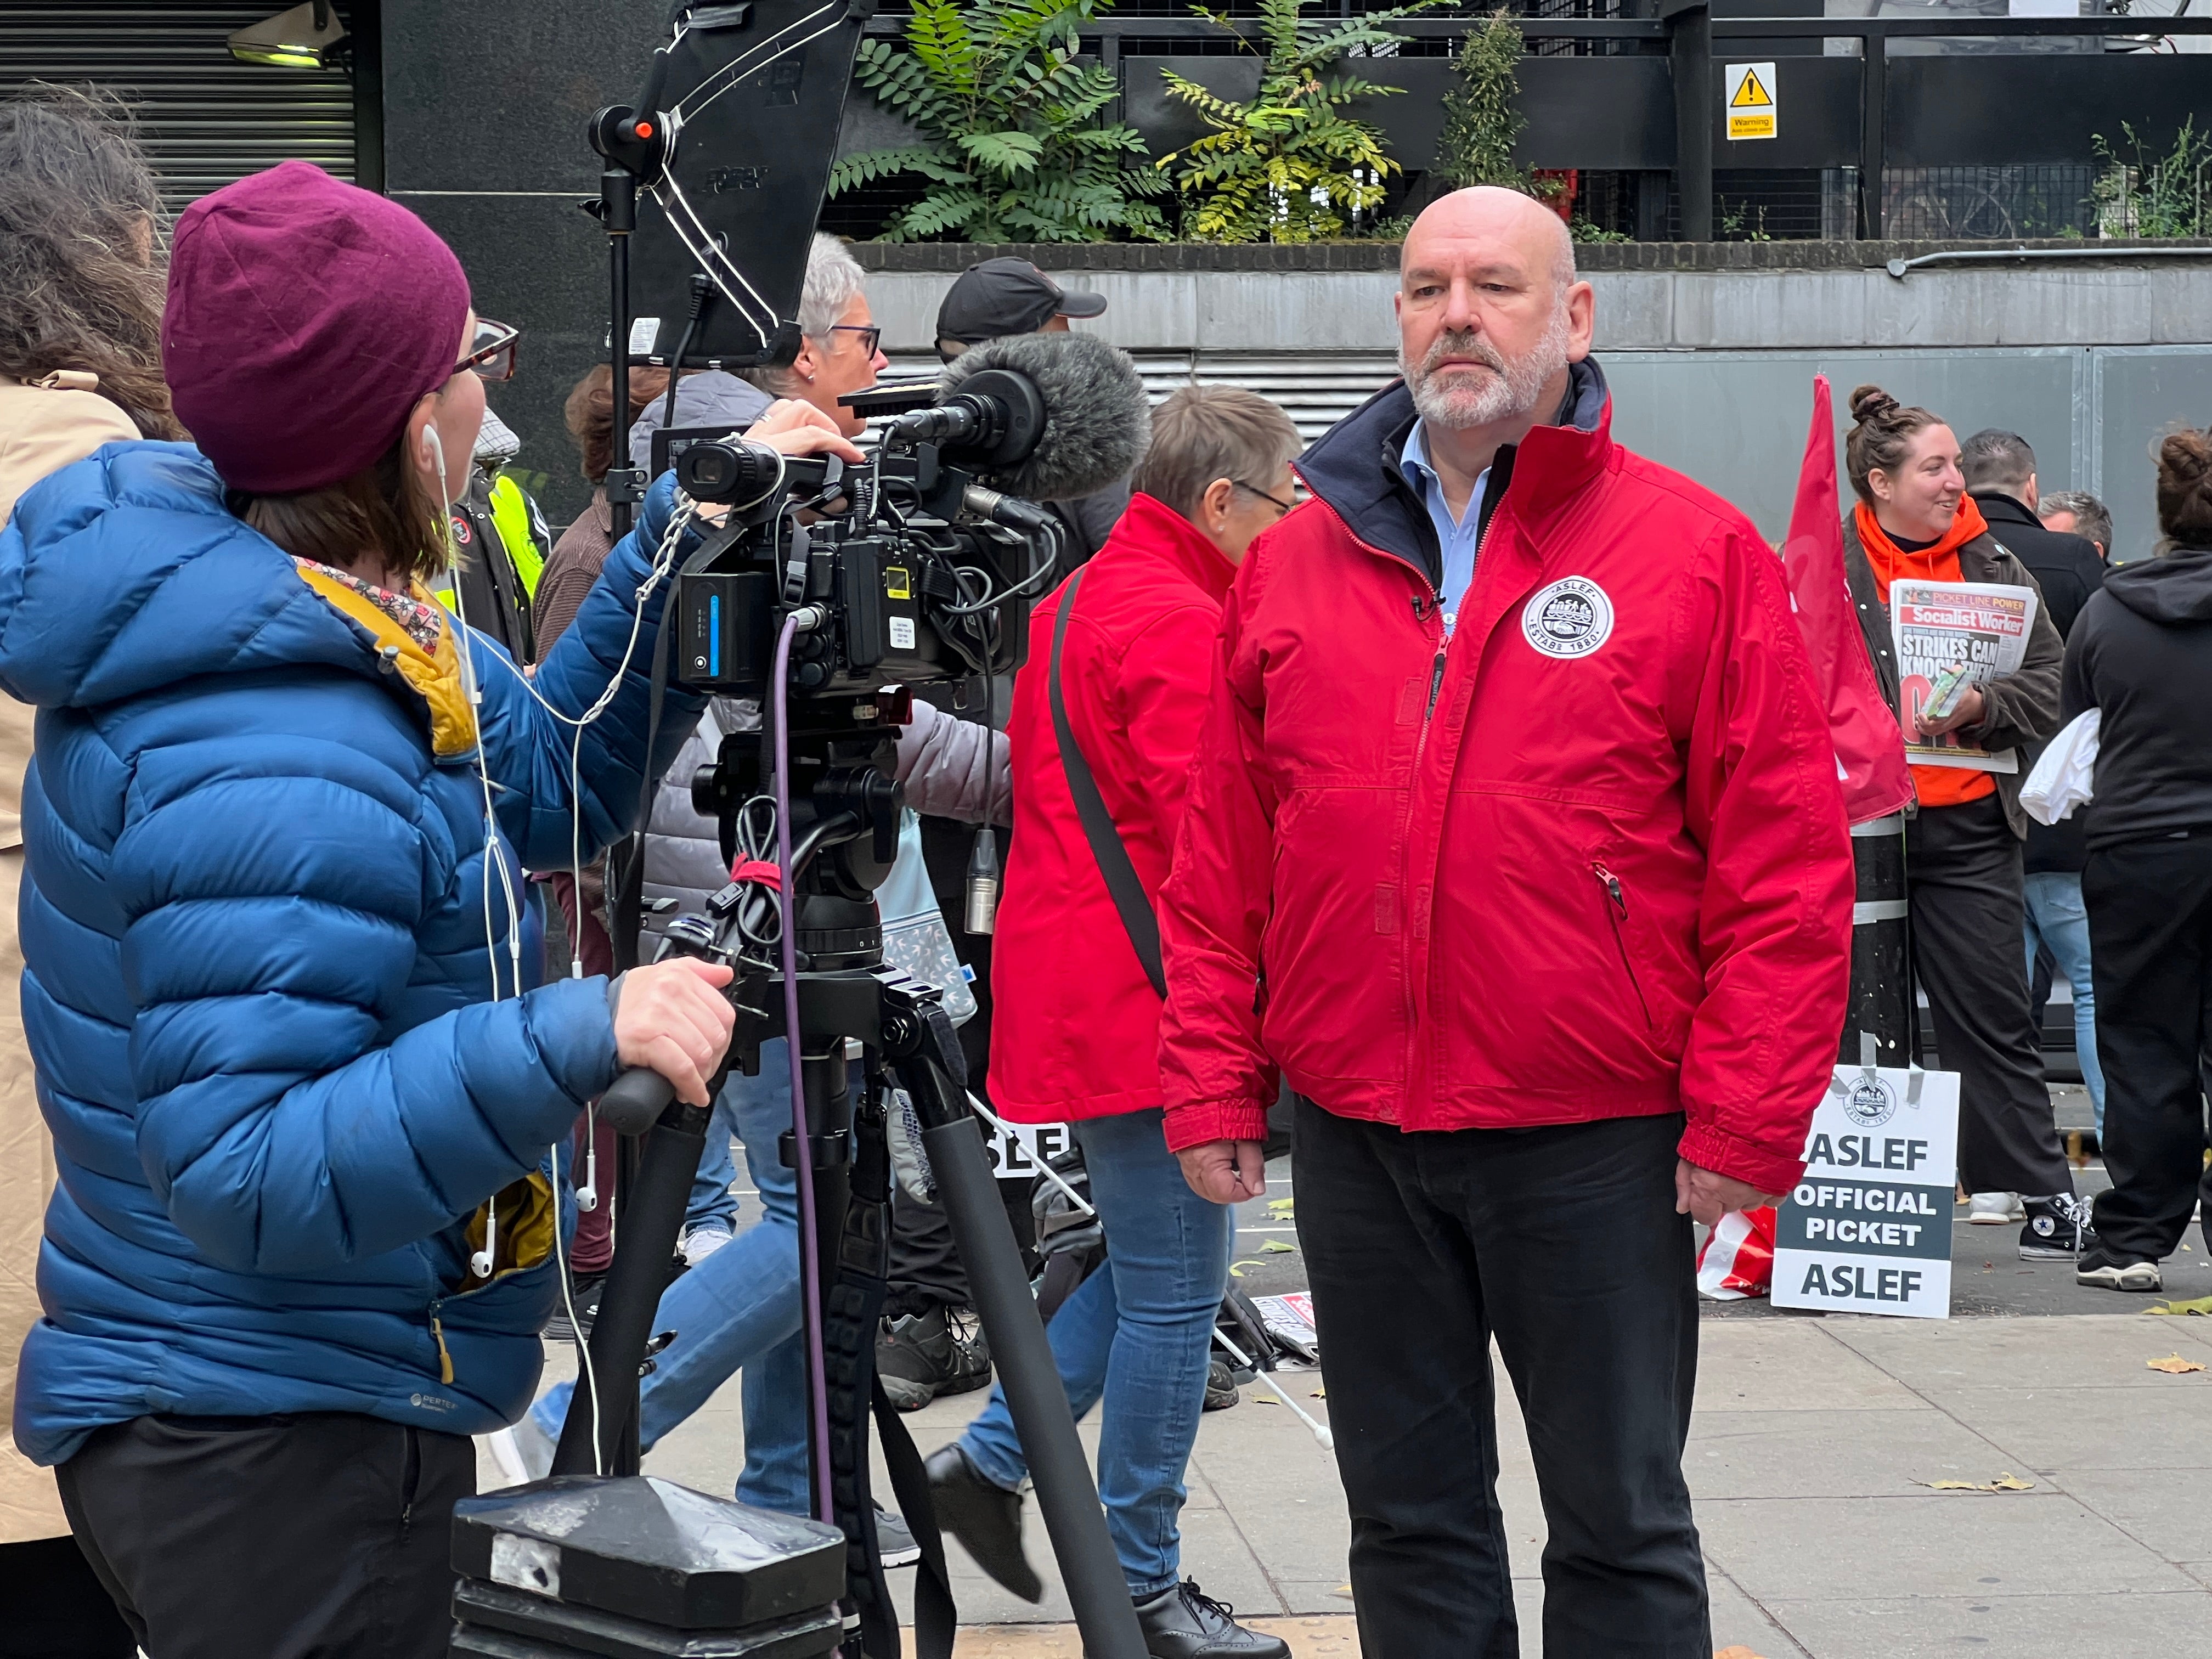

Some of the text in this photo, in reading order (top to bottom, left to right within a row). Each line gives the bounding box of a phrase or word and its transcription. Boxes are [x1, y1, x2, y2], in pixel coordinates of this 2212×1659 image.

[1556, 582, 1593, 594] ASLEF
[1933, 592, 1967, 603] PICKET
[1970, 596, 1990, 605] LINE
[1993, 598, 2024, 610] POWER
[1913, 606, 1976, 627] Socialist
[1977, 613, 2023, 633] Worker
[1570, 635, 1597, 650] 1880
[1903, 634, 1968, 660] STRIKES
[1971, 640, 1998, 664] CAN
[1808, 1133, 1928, 1170] ASLEF
[1793, 1184, 1937, 1215] OFFICIAL
[1806, 1218, 1922, 1246] PICKET
[1801, 1263, 1922, 1302] ASLEF
